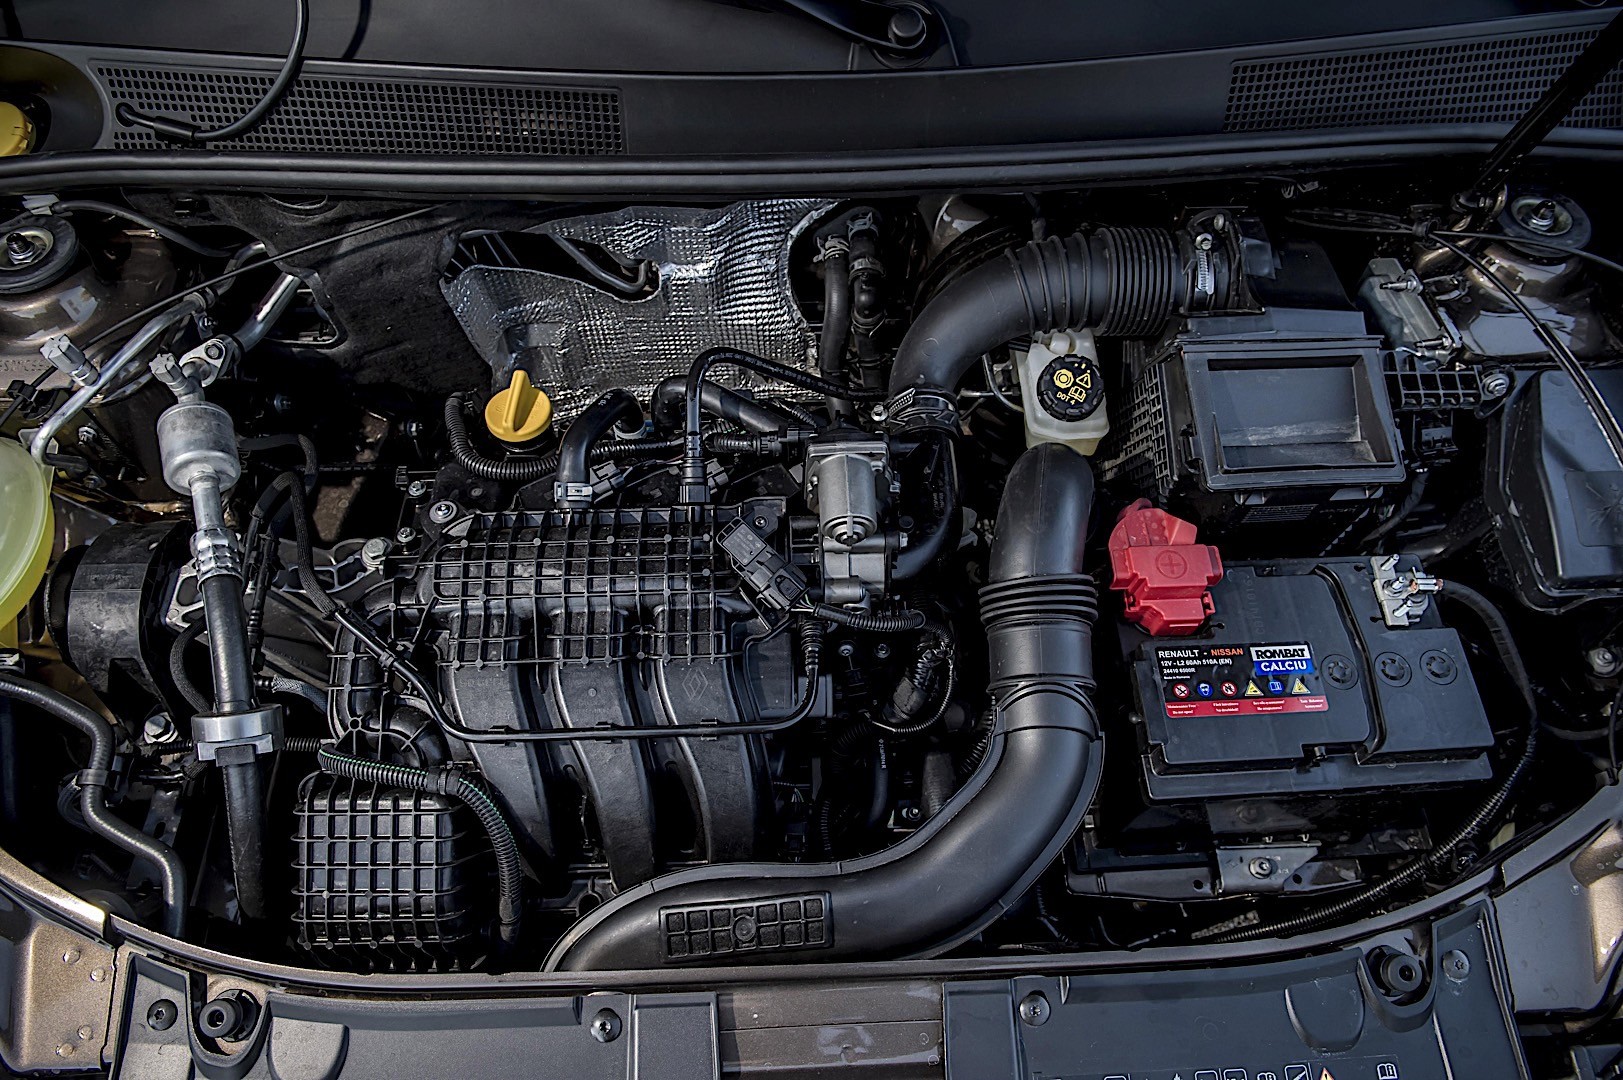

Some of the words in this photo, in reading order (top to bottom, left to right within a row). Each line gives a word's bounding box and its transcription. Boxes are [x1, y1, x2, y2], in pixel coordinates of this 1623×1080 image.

[1056, 391, 1070, 402] DOT
[1158, 649, 1199, 658] RENAULT
[1210, 647, 1244, 656] NISSAN
[1255, 648, 1305, 660] ROMBAT
[1260, 660, 1307, 672] CALCIU
